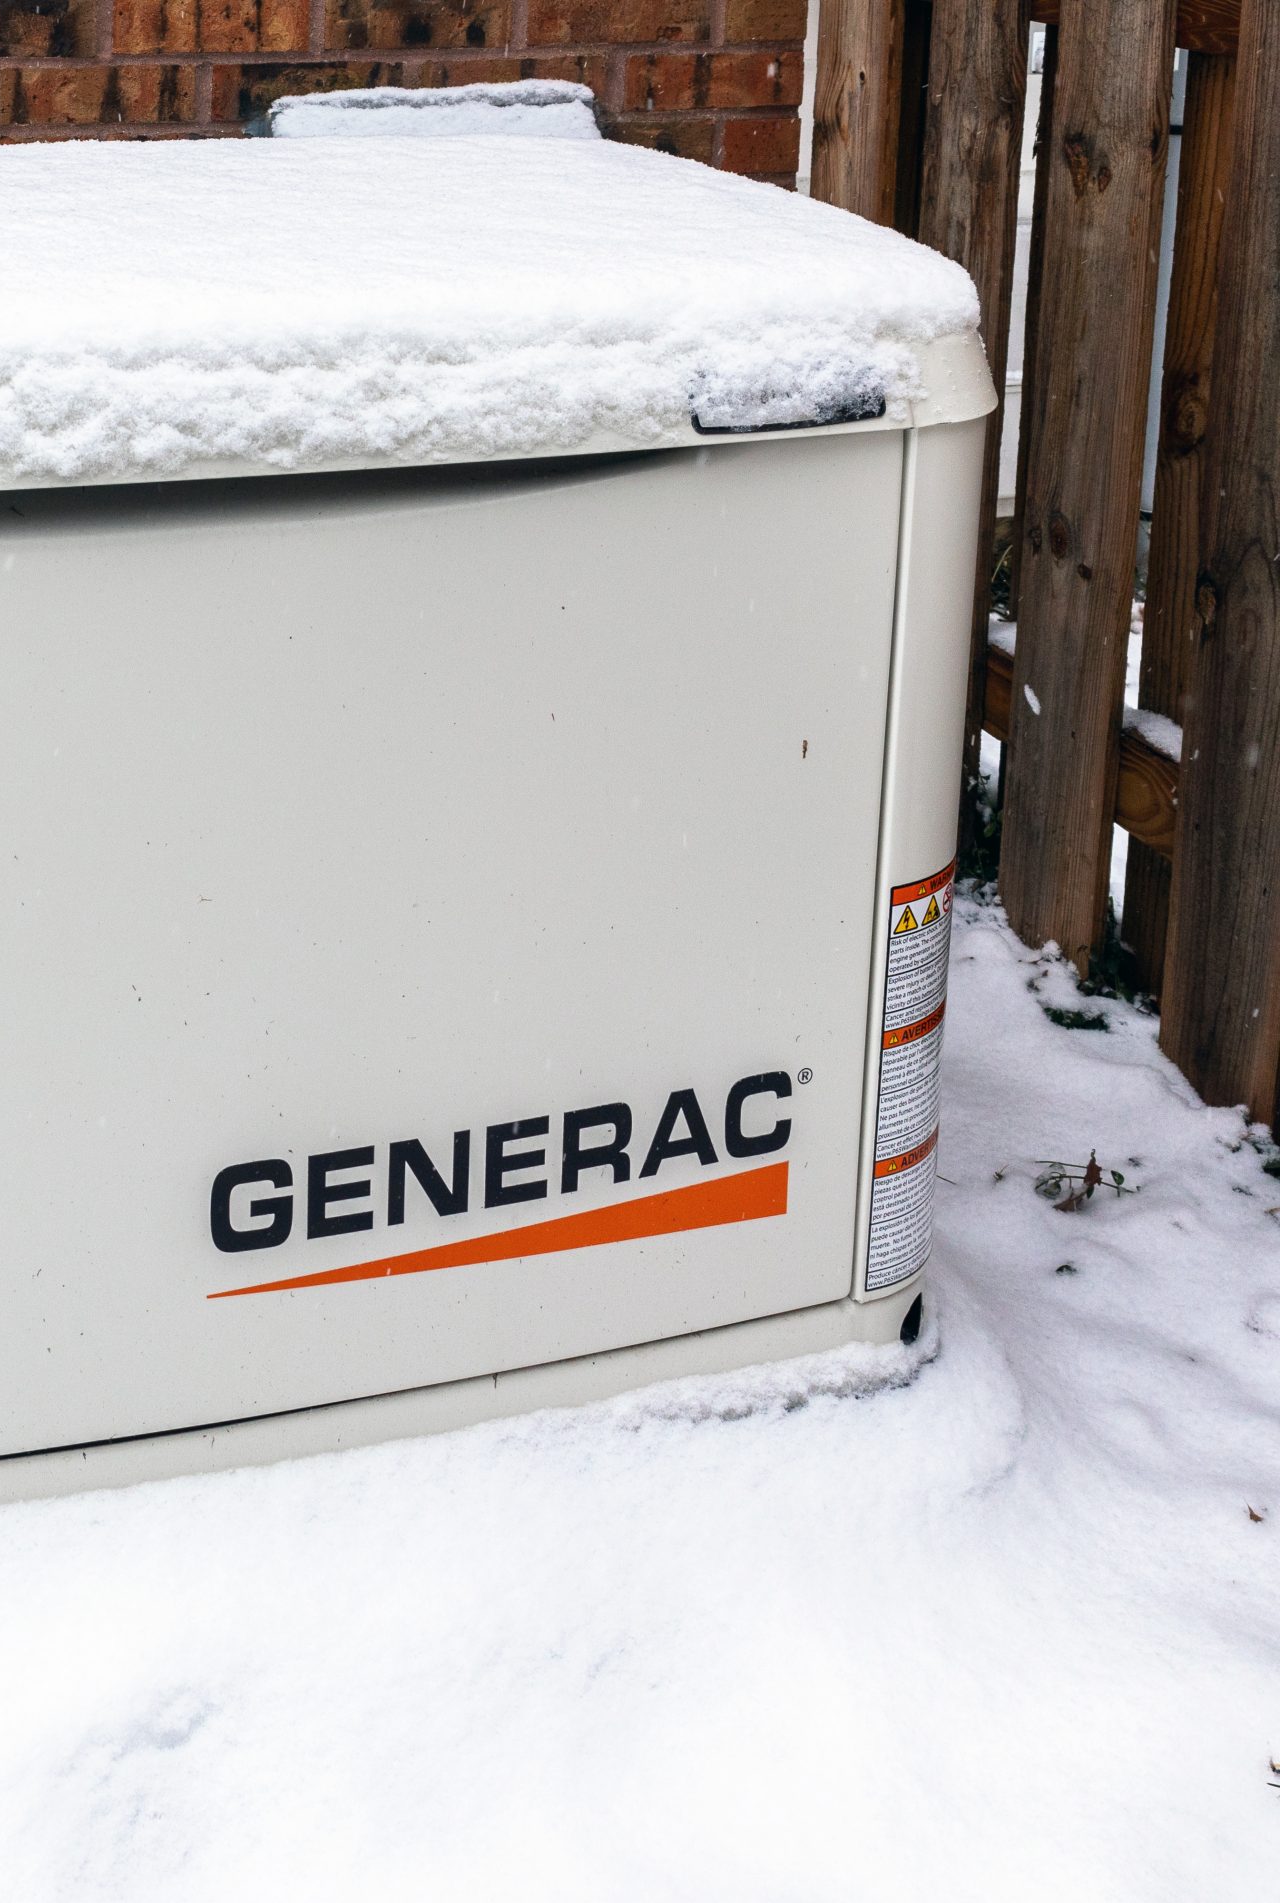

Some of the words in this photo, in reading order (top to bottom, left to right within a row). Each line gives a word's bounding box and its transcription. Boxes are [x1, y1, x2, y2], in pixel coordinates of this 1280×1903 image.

[902, 936, 909, 944] of
[890, 956, 908, 964] engine
[909, 946, 931, 959] generator
[889, 962, 913, 973] operated
[889, 973, 914, 985] Explosion
[888, 985, 905, 993] severe
[906, 980, 920, 990] injury
[887, 994, 902, 1002] strike
[907, 987, 921, 996] match
[886, 1001, 905, 1011] vicinity
[913, 995, 921, 1003] this
[886, 1012, 905, 1022] Cancer
[905, 1008, 914, 1016] and
[883, 1055, 907, 1065] réparable
[908, 1052, 916, 1060] par
[884, 1048, 902, 1057] Risque
[882, 1064, 906, 1075] panneau
[882, 1074, 901, 1084] destiné
[906, 1067, 915, 1076] être
[881, 1080, 907, 1092] personnel
[881, 1089, 909, 1103] L'explosion
[880, 1103, 898, 1112] causer
[899, 1099, 907, 1108] des
[880, 1114, 887, 1122] Ne
[888, 1112, 897, 1120] pas
[879, 1119, 903, 1130] allumette
[878, 1126, 904, 1140] proximité
[877, 1142, 896, 1152] Cancer
[874, 1187, 891, 1195] piezas
[892, 1183, 902, 1191] que
[875, 1178, 893, 1187] Riesgo
[873, 1193, 894, 1203] control
[894, 1188, 908, 1199] panel
[885, 1195, 910, 1209] destinado
[873, 1213, 882, 1221] por
[883, 1204, 906, 1217] personal
[871, 1234, 888, 1242] puede
[889, 1229, 904, 1239] causar
[876, 1250, 889, 1258] haga
[869, 1270, 891, 1280] Produce
